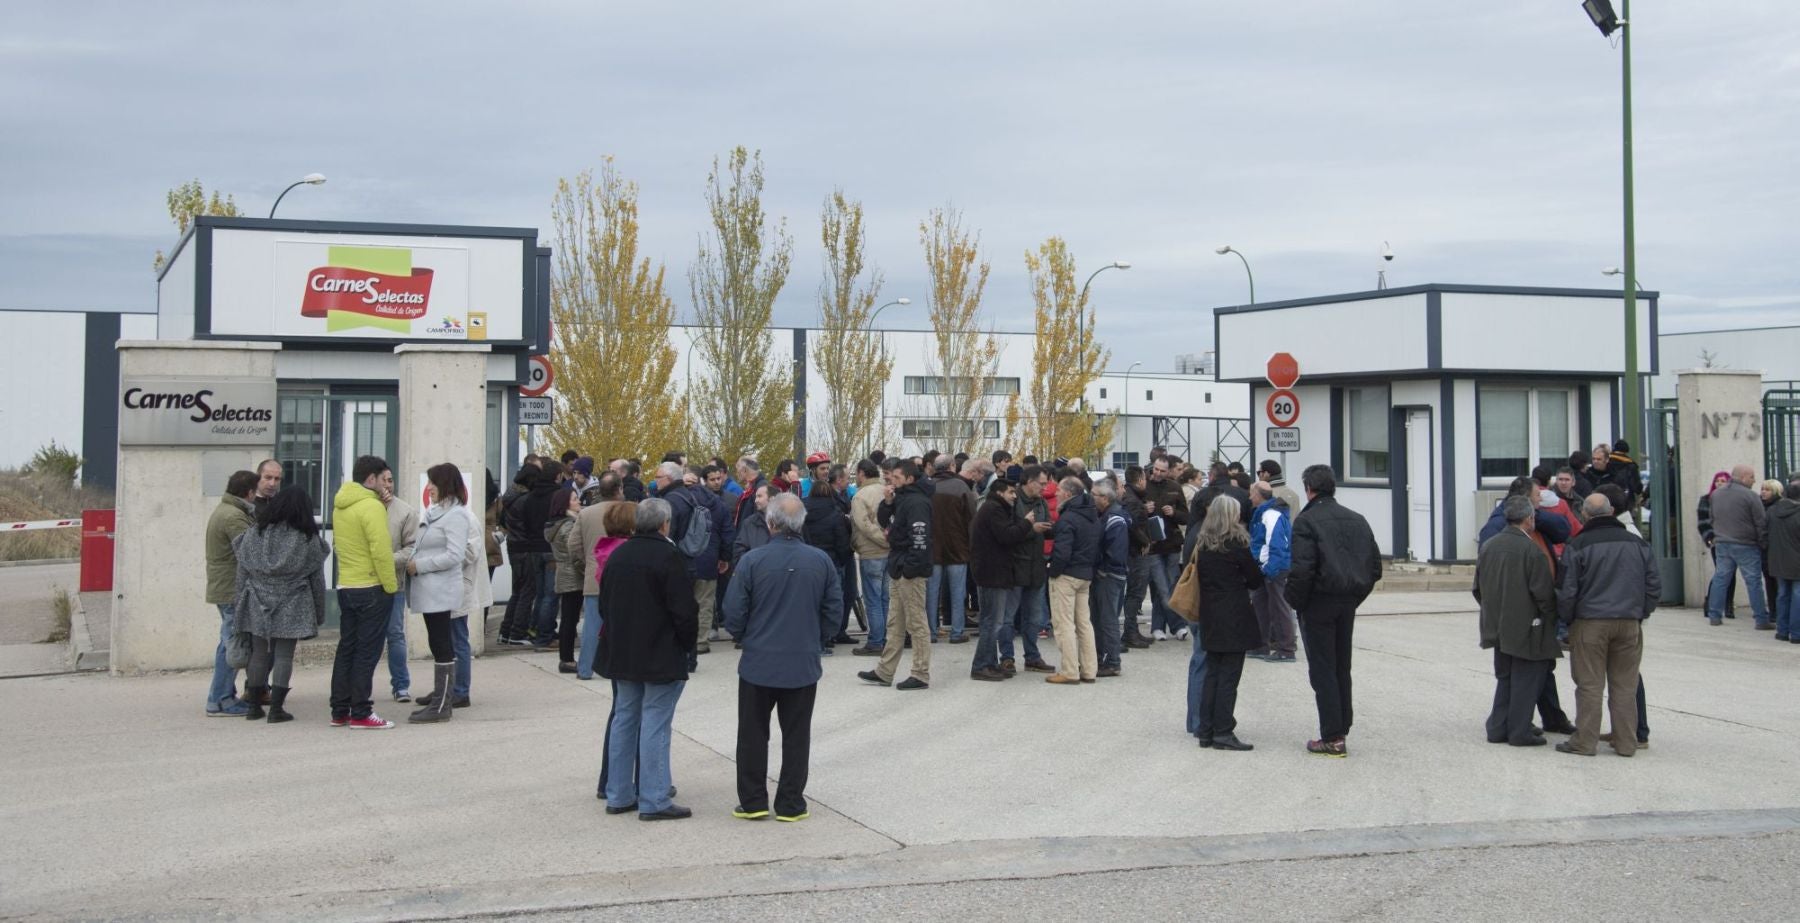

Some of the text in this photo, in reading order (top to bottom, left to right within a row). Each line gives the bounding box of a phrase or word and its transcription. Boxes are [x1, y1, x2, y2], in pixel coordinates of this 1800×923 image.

[1271, 367, 1295, 375] TOP
[529, 401, 545, 409] TODO
[1274, 403, 1292, 414] 20
[524, 411, 549, 420] RECINTO
[237, 426, 245, 435] de
[1273, 431, 1294, 439] EN TODO
[1271, 440, 1297, 448] EL RECINTO
